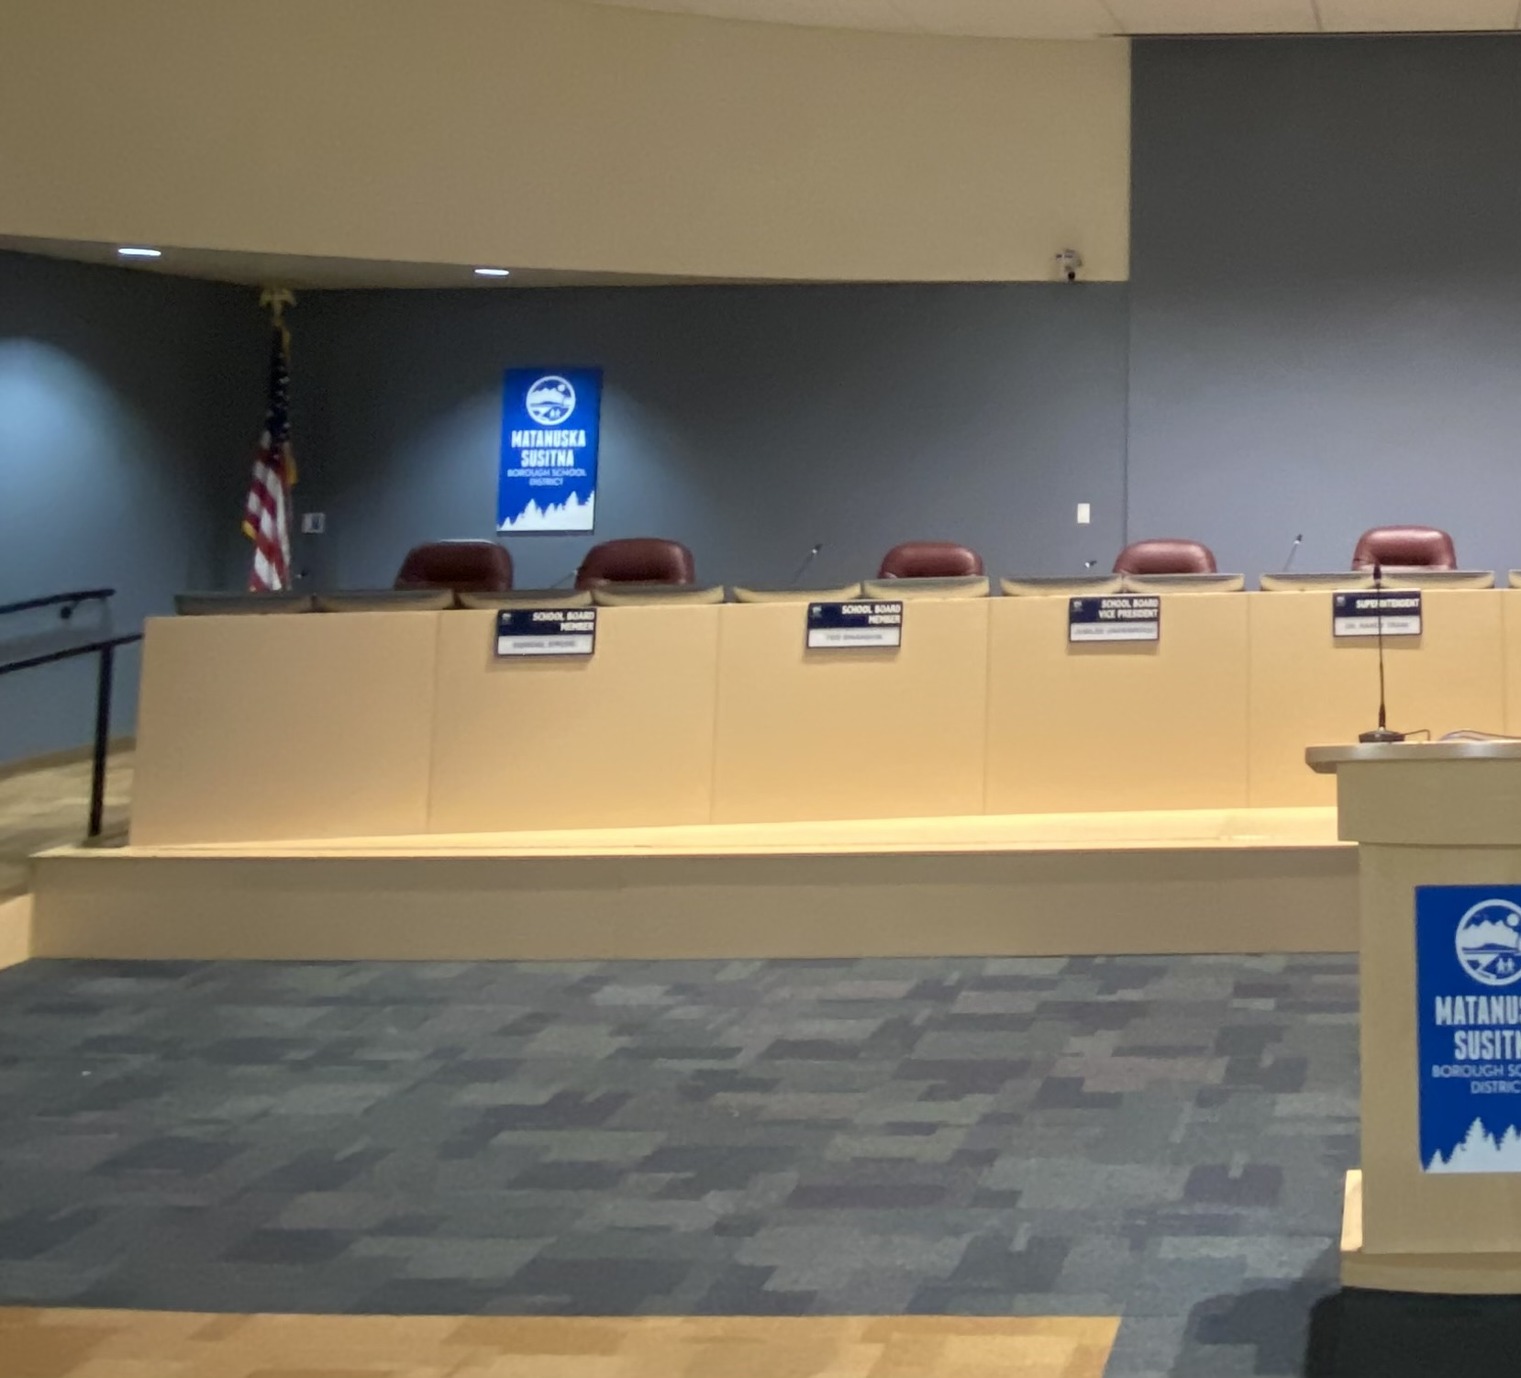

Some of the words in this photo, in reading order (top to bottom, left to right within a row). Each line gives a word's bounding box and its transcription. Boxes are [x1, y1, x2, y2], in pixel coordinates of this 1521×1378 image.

[511, 430, 586, 448] MATANUSKA
[521, 450, 574, 467] SUSITNA
[507, 469, 550, 477] BOROUGH
[552, 469, 587, 477] SCHOOL
[529, 478, 563, 486] DISTRICT
[1101, 599, 1132, 608] SCHOOL
[1132, 598, 1159, 608] BOARD
[841, 605, 873, 615] SCHOOL
[874, 604, 901, 613] BOARD
[1098, 609, 1116, 618] VICE
[1117, 608, 1158, 618] PRESIDENT
[532, 612, 564, 621] SCHOOL
[566, 611, 595, 621] BOARD
[868, 615, 900, 624] MEMBER
[560, 622, 594, 631] MEMBER
[1432, 1064, 1504, 1078] BOROUGH
